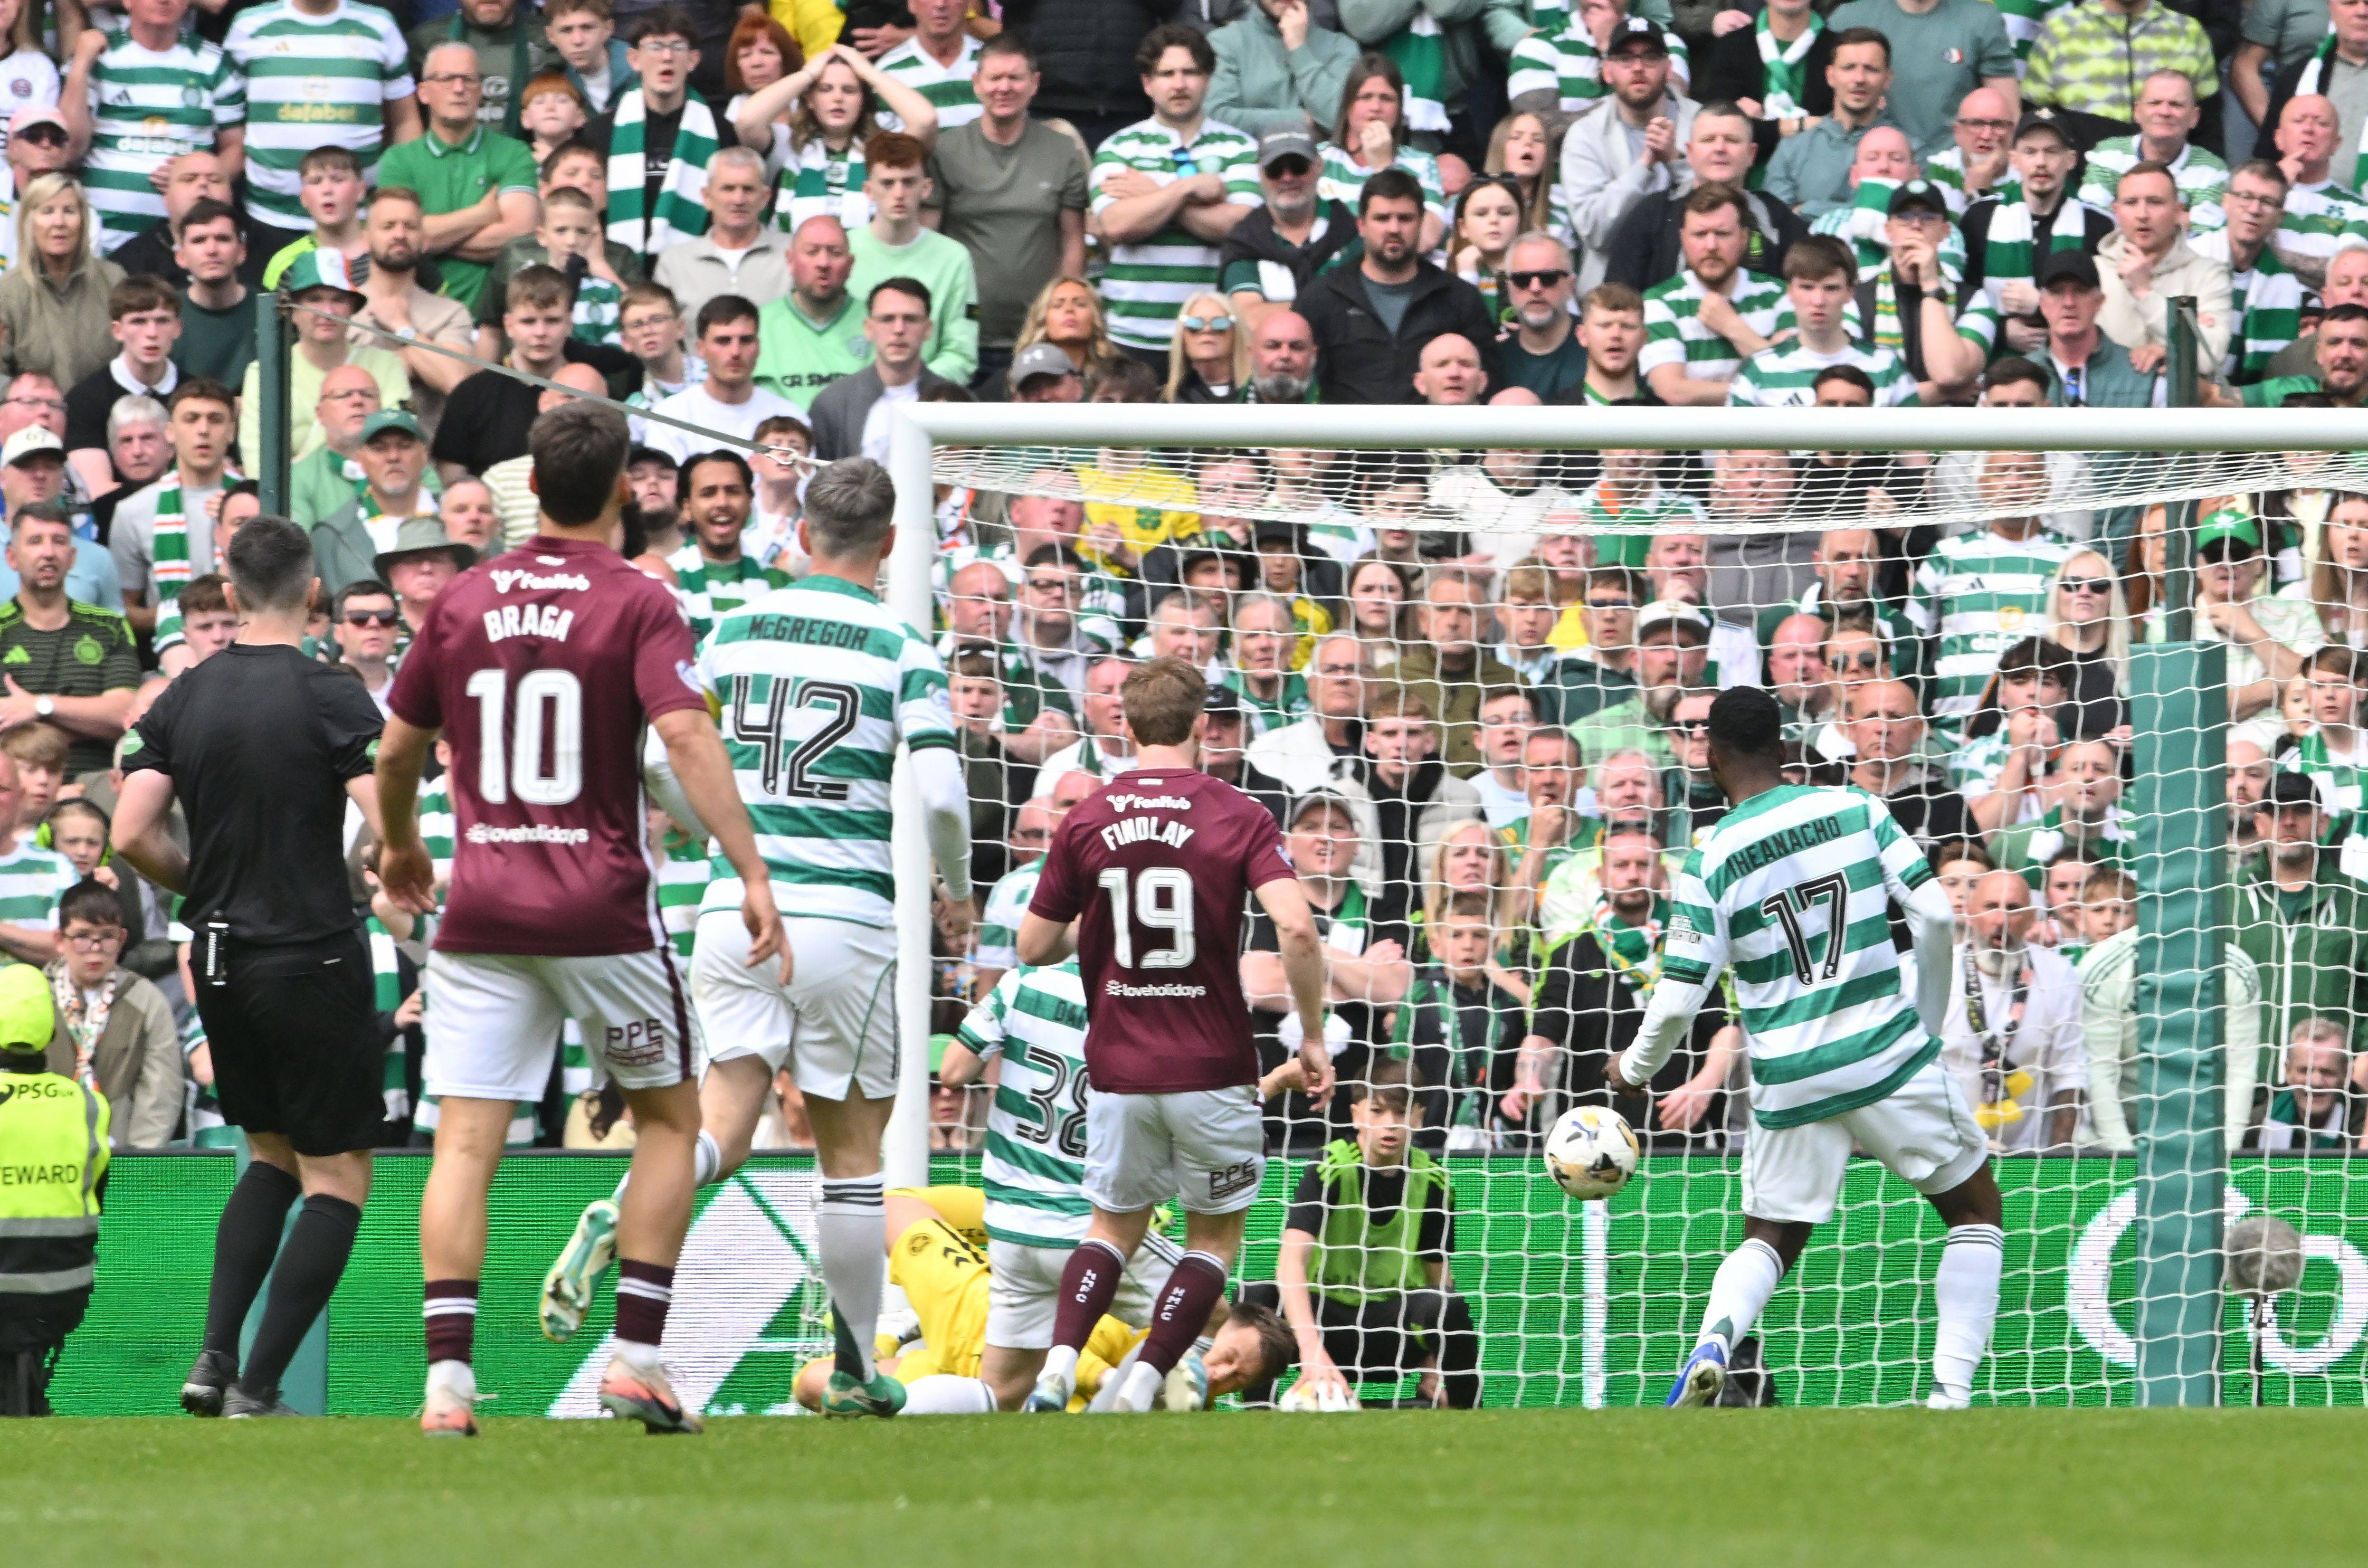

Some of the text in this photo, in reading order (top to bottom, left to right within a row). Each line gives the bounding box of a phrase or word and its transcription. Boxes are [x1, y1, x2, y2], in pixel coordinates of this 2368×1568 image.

[483, 603, 574, 643] BRAGA
[748, 615, 869, 651] McGREGOR
[465, 669, 582, 804] 10
[733, 674, 862, 802] 42
[1133, 796, 1191, 810] FanHub
[1100, 816, 1195, 851] FINDLAY
[1726, 815, 1841, 879] IHEANACHO
[1098, 867, 1196, 968] 19
[1761, 869, 1850, 987] 17
[1123, 983, 1206, 998] loveholidays
[606, 1018, 662, 1050] PPE
[1, 1164, 79, 1185] EWARD
[1210, 1157, 1254, 1189] PPE
